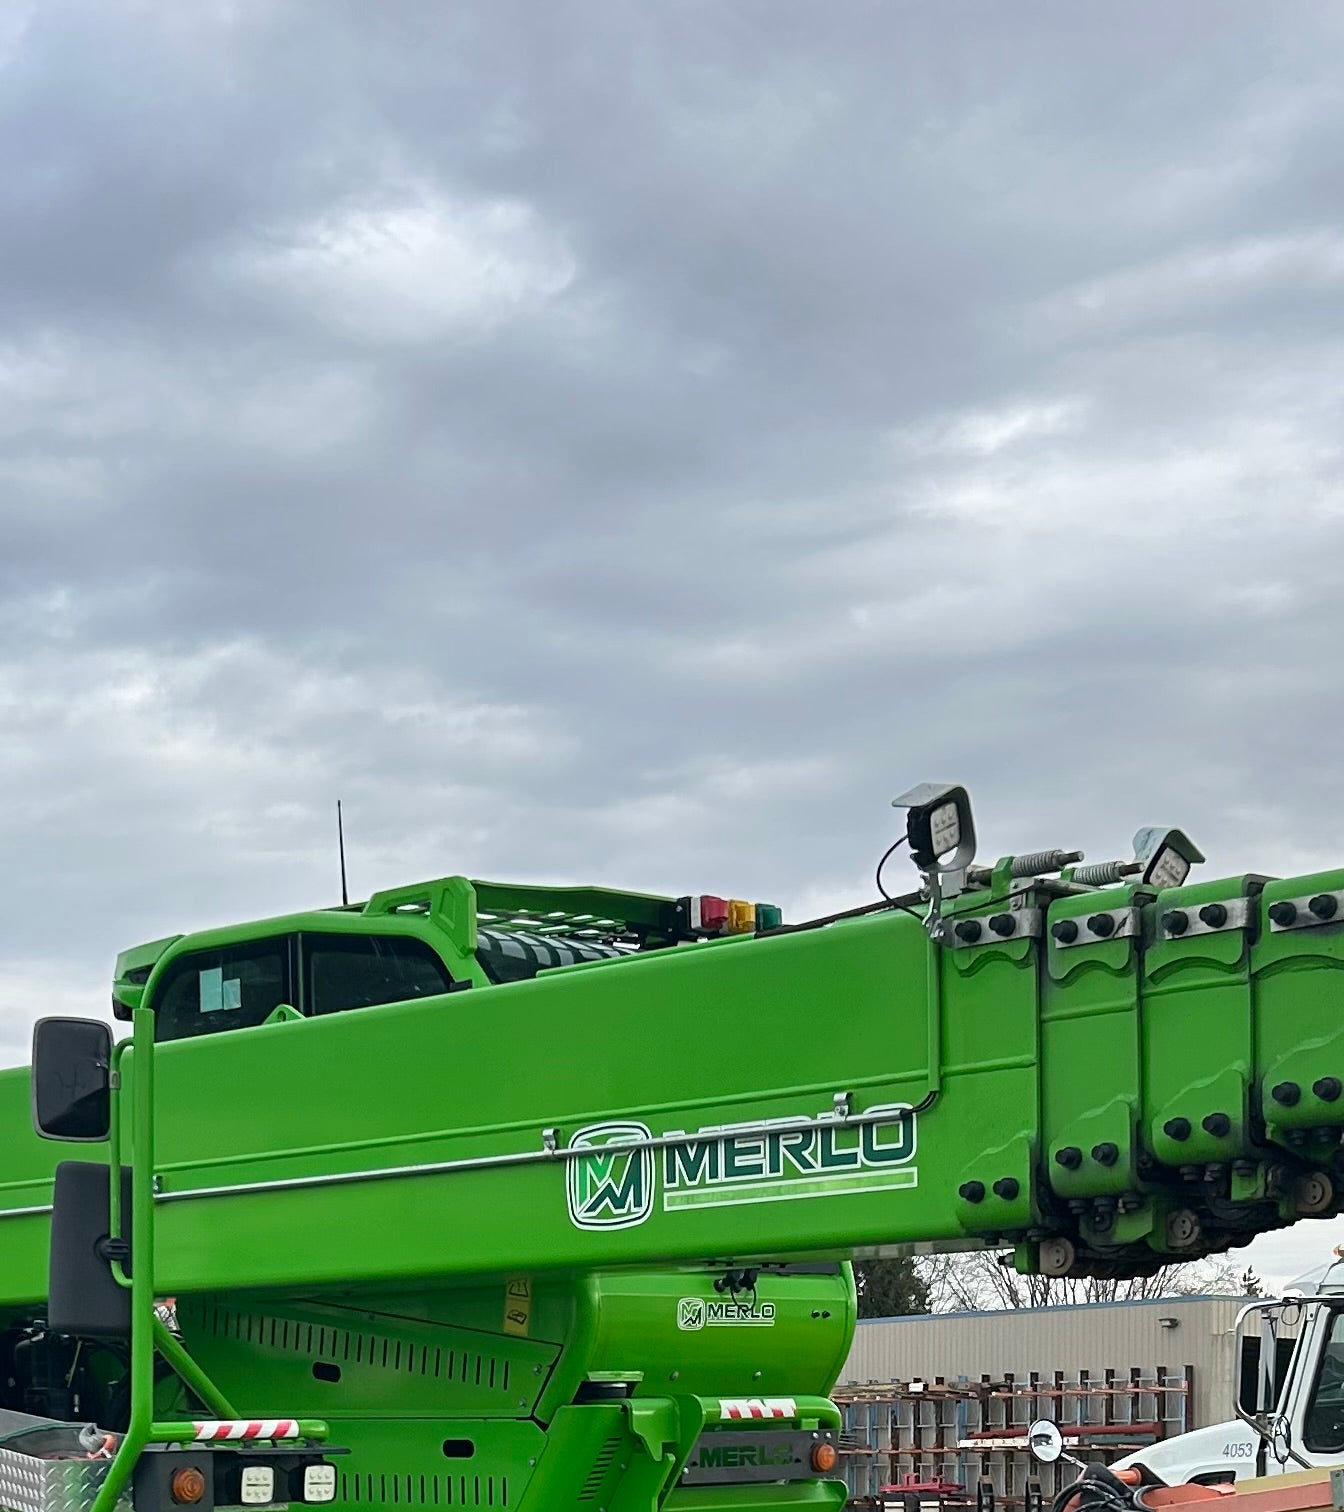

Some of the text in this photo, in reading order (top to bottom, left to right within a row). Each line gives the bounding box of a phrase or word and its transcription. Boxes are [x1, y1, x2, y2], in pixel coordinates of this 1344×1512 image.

[663, 1103, 917, 1188] MERLO
[706, 1303, 775, 1320] MERLO
[1222, 1442, 1254, 1458] 4053
